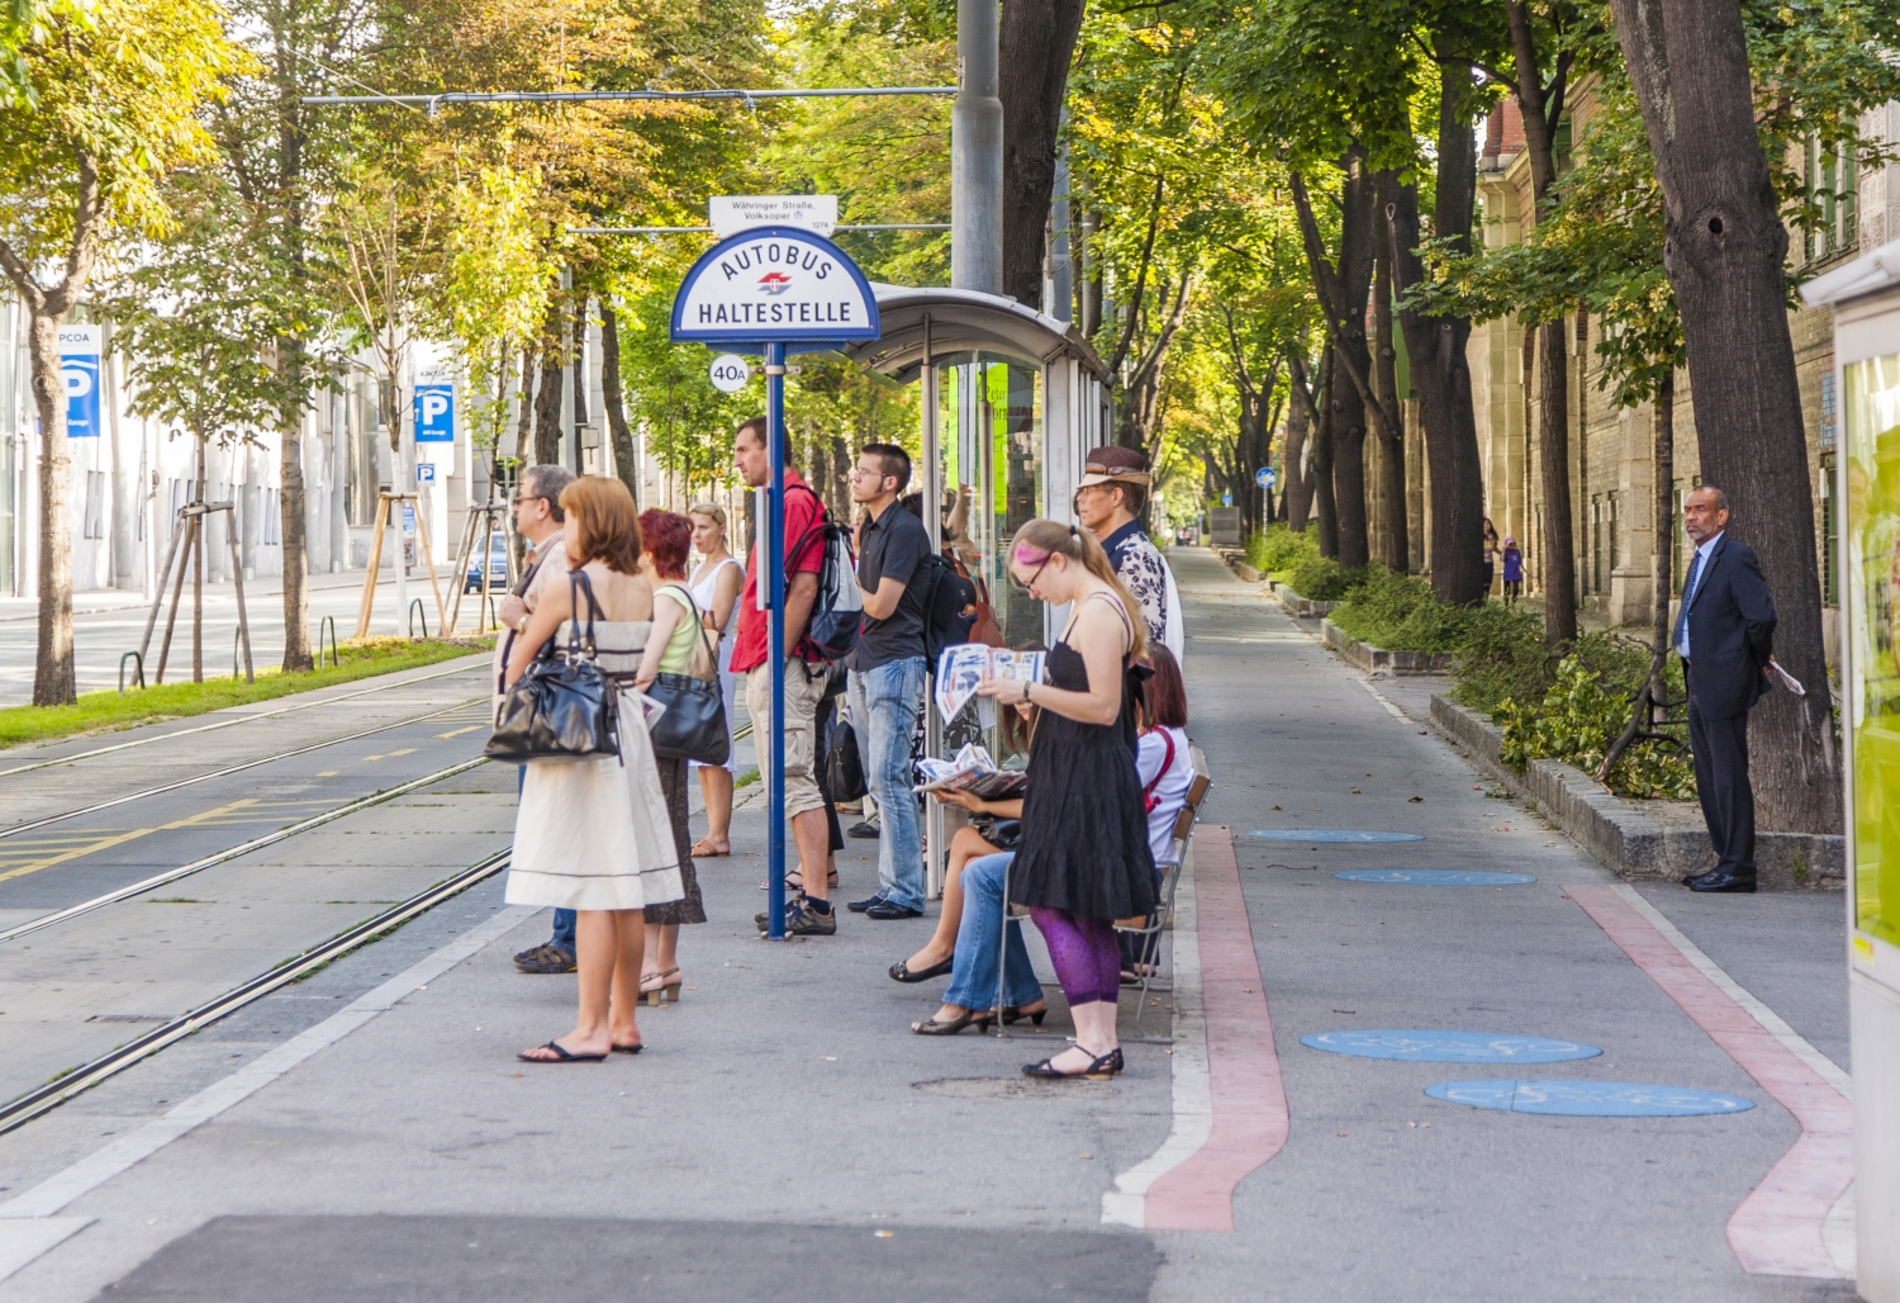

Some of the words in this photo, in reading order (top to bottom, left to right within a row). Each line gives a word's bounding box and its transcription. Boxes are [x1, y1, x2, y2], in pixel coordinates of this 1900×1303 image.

[732, 201, 778, 211] Währinger
[782, 201, 816, 210] Straße,
[744, 211, 790, 220] Volksoper
[812, 221, 828, 229] 1274
[720, 243, 832, 281] AUTOBUS
[699, 302, 851, 323] HALTESTELLE
[59, 333, 90, 343] PCOA
[713, 365, 746, 381] 40A
[62, 369, 92, 411] P
[422, 395, 448, 426] P
[420, 468, 433, 481] P
